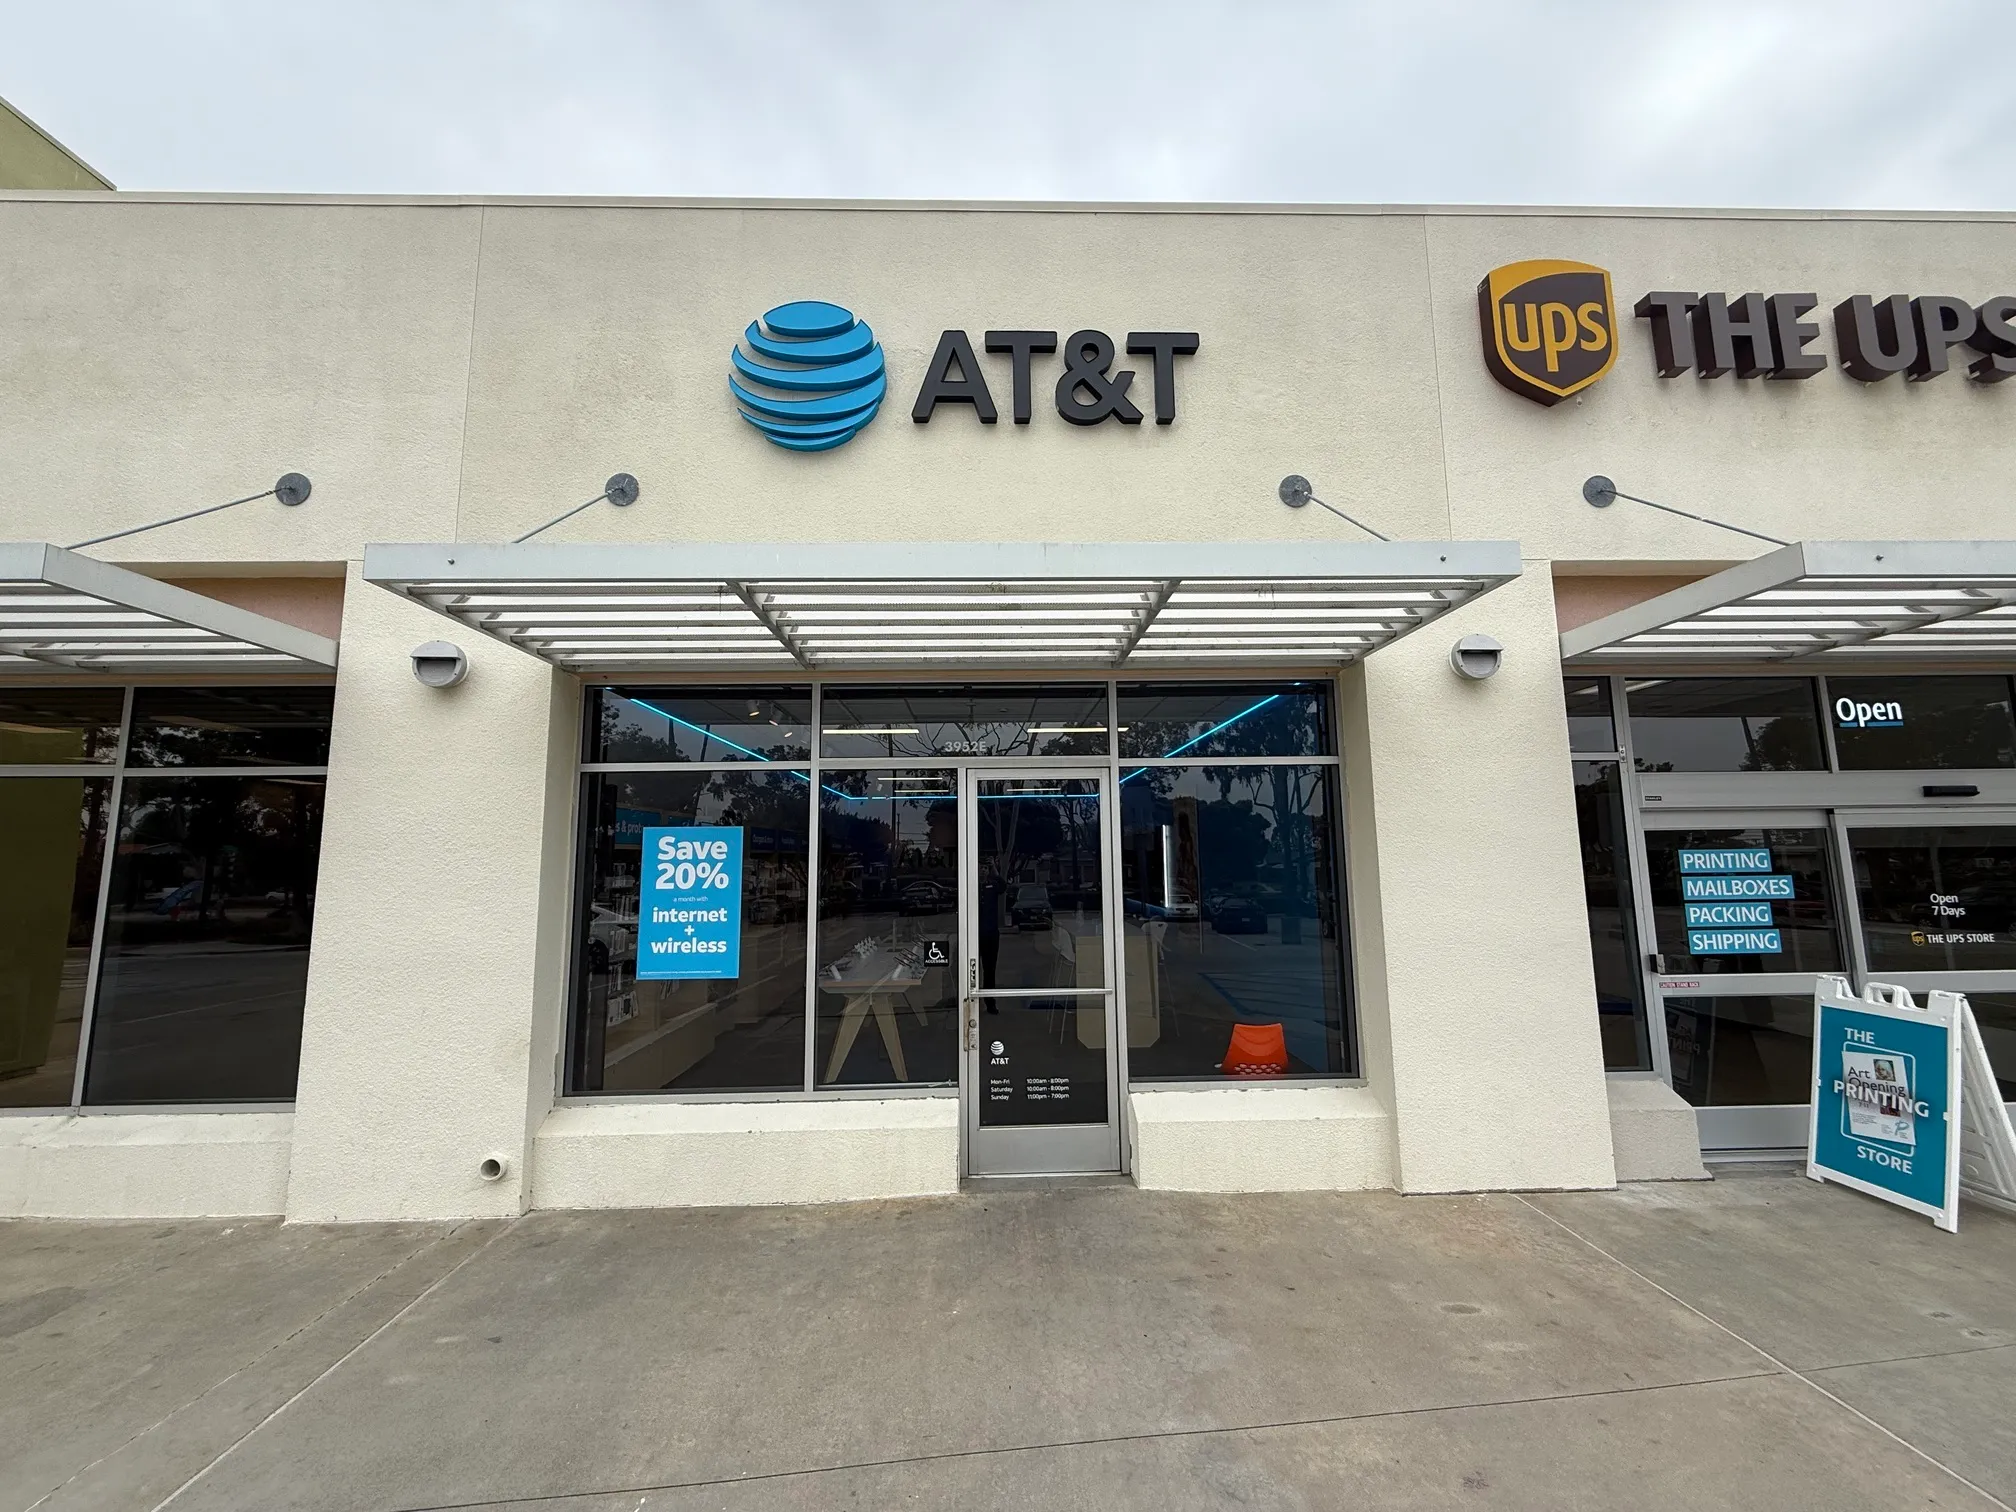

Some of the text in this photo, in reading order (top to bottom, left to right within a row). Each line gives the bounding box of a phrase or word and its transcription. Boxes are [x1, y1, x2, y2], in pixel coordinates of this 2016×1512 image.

[1504, 302, 1608, 373] ups
[1634, 291, 2016, 383] THE UPS
[911, 329, 1200, 426] AT&T
[1836, 697, 1903, 728] Open
[657, 835, 728, 861] Save
[1682, 852, 1769, 869] PRINTING
[655, 862, 729, 890] 20%
[1687, 879, 1790, 896] MAILBOXES
[1930, 893, 1959, 905] Open
[652, 906, 728, 923] internet
[1689, 906, 1769, 923] PACKING
[1931, 905, 1966, 918] 7 Days
[684, 925, 695, 936] +
[1926, 933, 1996, 944] THE UPS STORE
[650, 937, 727, 954] wireless
[1692, 933, 1778, 950] SHIPPING
[1844, 1027, 1875, 1045] THE
[990, 1057, 1010, 1065] AT&T
[1848, 1066, 1871, 1079] Art
[1849, 1077, 1906, 1098] Opening
[1833, 1079, 1929, 1118] PRINTING
[1857, 1145, 1913, 1175] STORE
